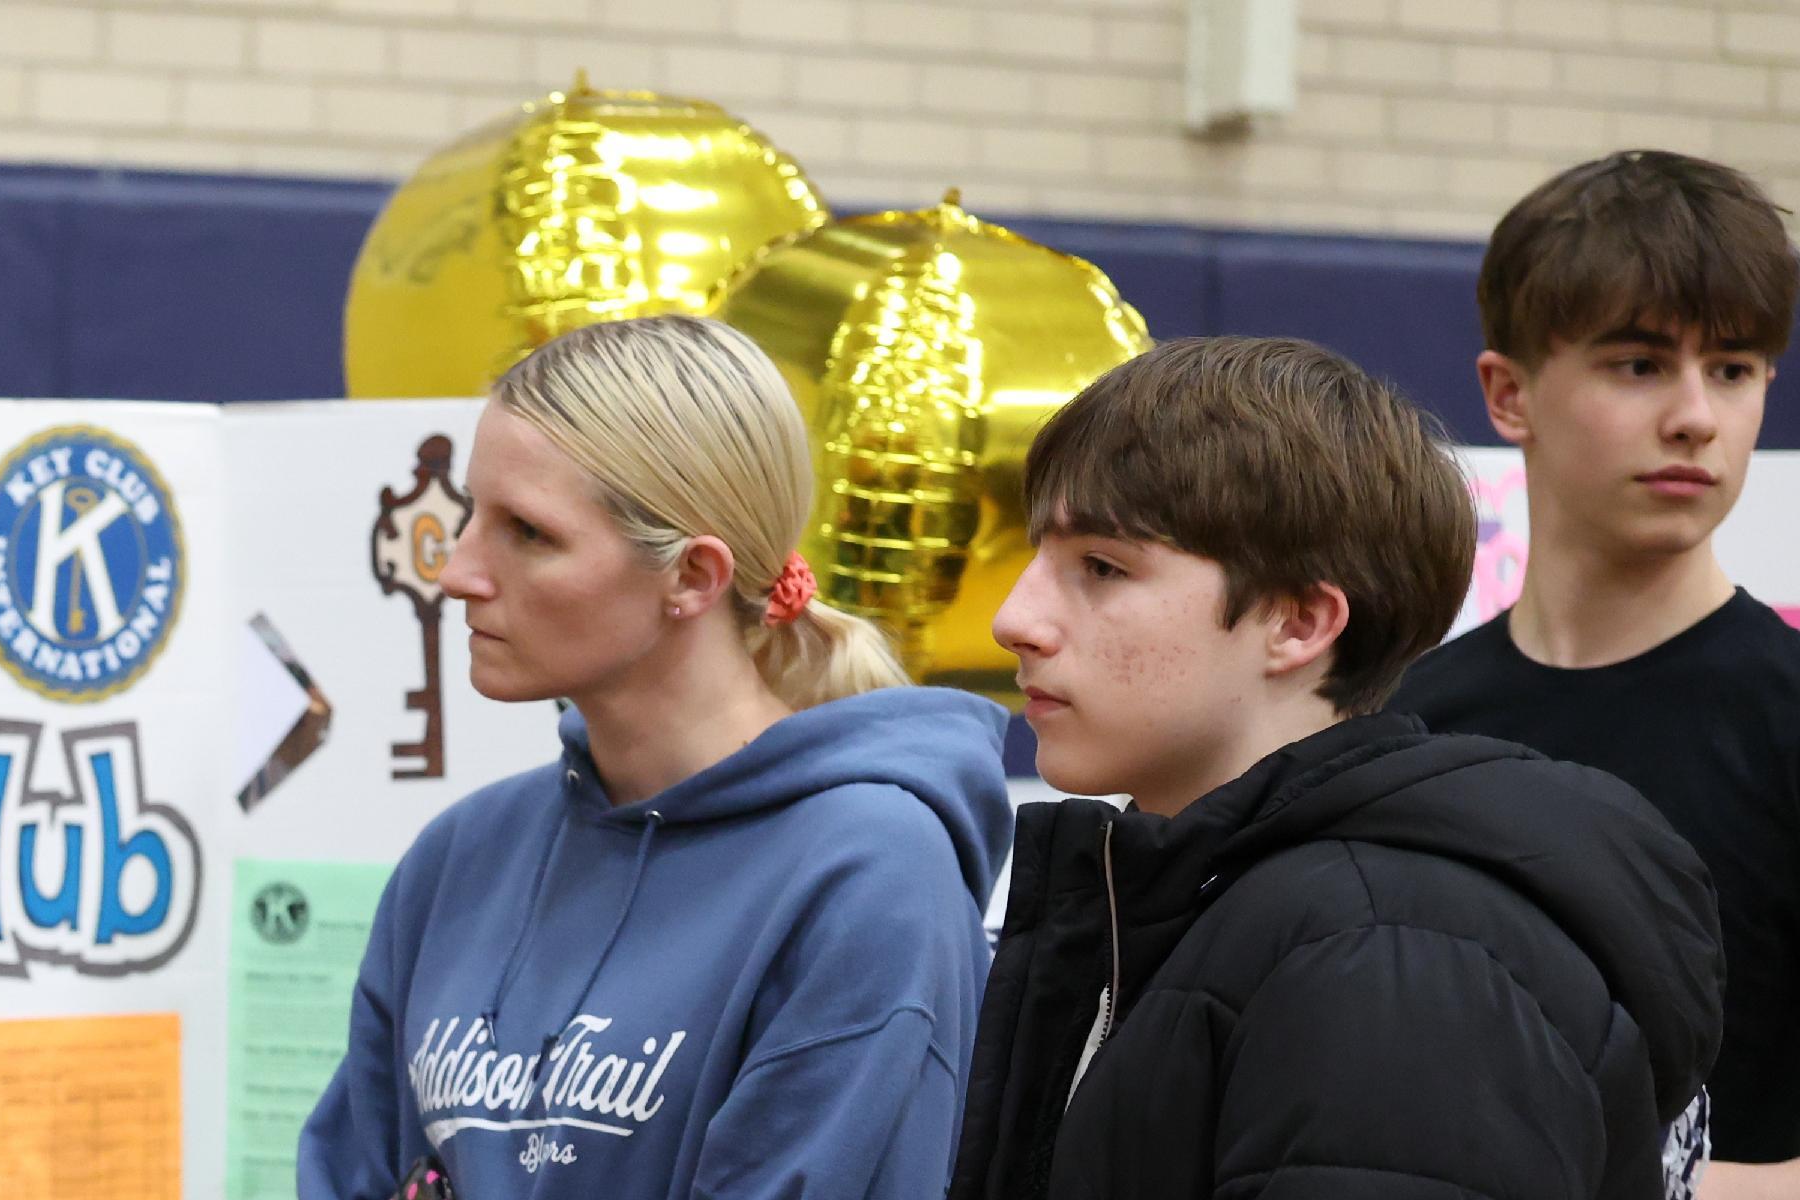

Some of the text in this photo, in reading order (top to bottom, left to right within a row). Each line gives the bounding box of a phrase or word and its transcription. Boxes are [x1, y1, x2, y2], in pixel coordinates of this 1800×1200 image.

[4, 447, 160, 525] KEY CLUB
[27, 478, 130, 643] K
[542, 1014, 676, 1122] Trail
